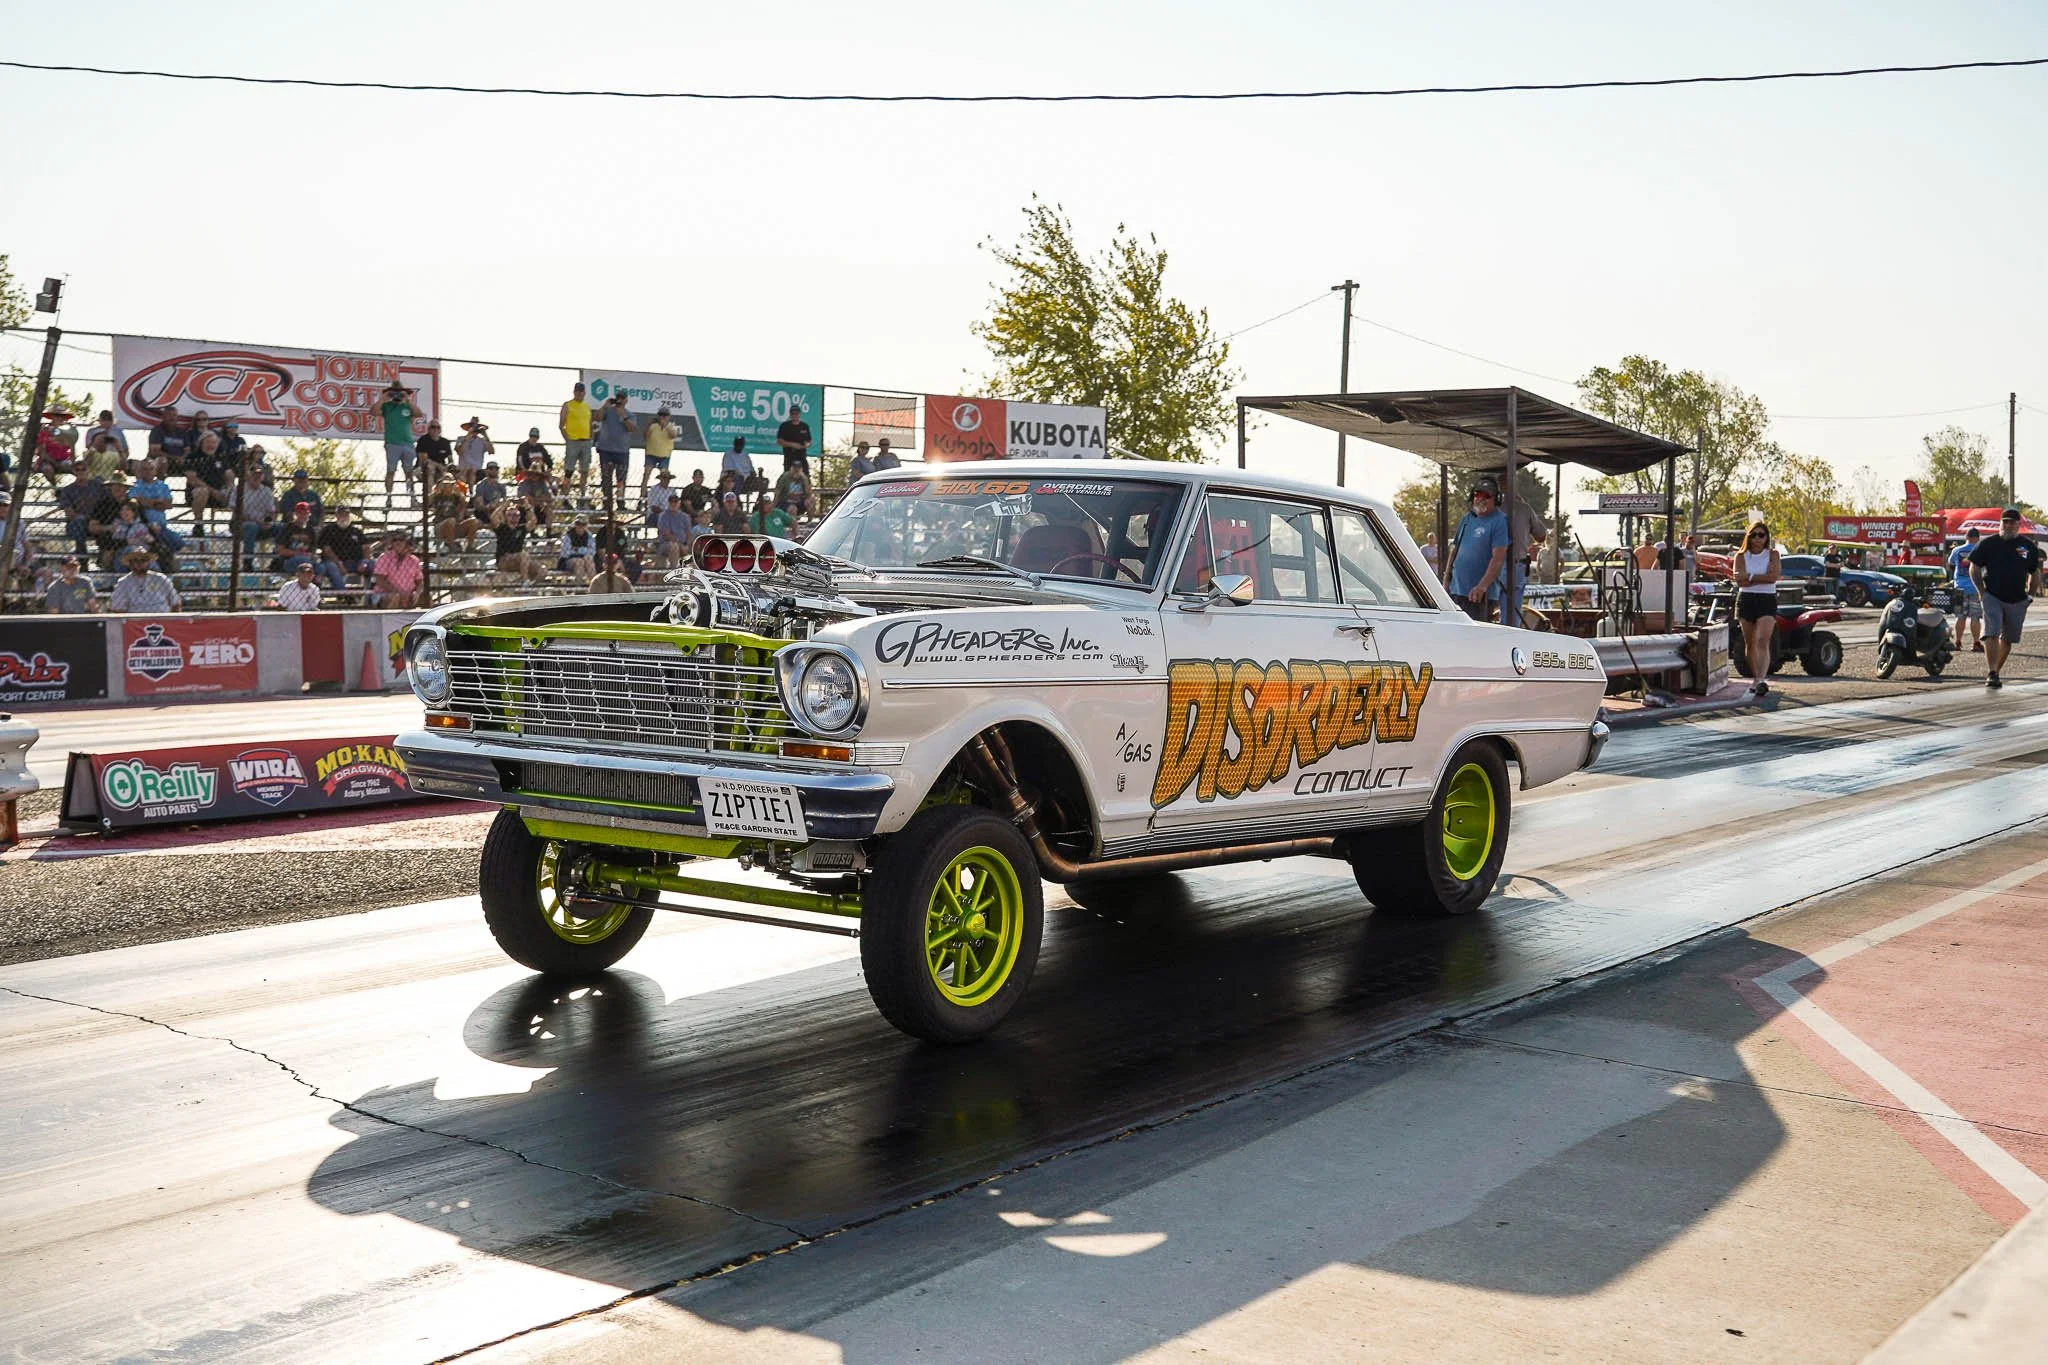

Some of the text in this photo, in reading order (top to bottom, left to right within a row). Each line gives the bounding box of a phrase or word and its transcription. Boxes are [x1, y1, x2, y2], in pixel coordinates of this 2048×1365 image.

[312, 355, 403, 384] JOHN
[148, 365, 284, 415] JCR
[710, 386, 747, 402] Save
[710, 404, 746, 420] up to
[752, 389, 809, 422] 50%
[286, 405, 428, 435] ROOFIG
[710, 424, 722, 433] on
[724, 424, 756, 434] annual
[1010, 420, 1103, 448] KUBOTA
[982, 481, 1031, 496] 66
[1042, 482, 1114, 492] OVERDRIVE
[1861, 521, 1904, 531] WINNER'S
[1867, 530, 1897, 539] CIRCLE
[189, 643, 255, 666] ZERO
[1568, 653, 1594, 670] BBC
[0, 655, 66, 682] Prix
[26, 690, 65, 701] CENTER
[1150, 658, 1432, 808] DISORDERLY
[231, 758, 303, 783] WDRA
[334, 765, 393, 781] DRAGWAY
[106, 764, 213, 804] O'Reilly
[350, 780, 367, 789] Since
[1294, 766, 1413, 795] CONDUCT
[261, 791, 283, 799] TRACK
[366, 785, 391, 796] Missouri
[144, 803, 198, 818] AUTO PARTS
[708, 791, 794, 824] ZIPTIE1
[714, 822, 798, 836] PEACE GARDEN STATE
[813, 853, 853, 866] MOROSO
